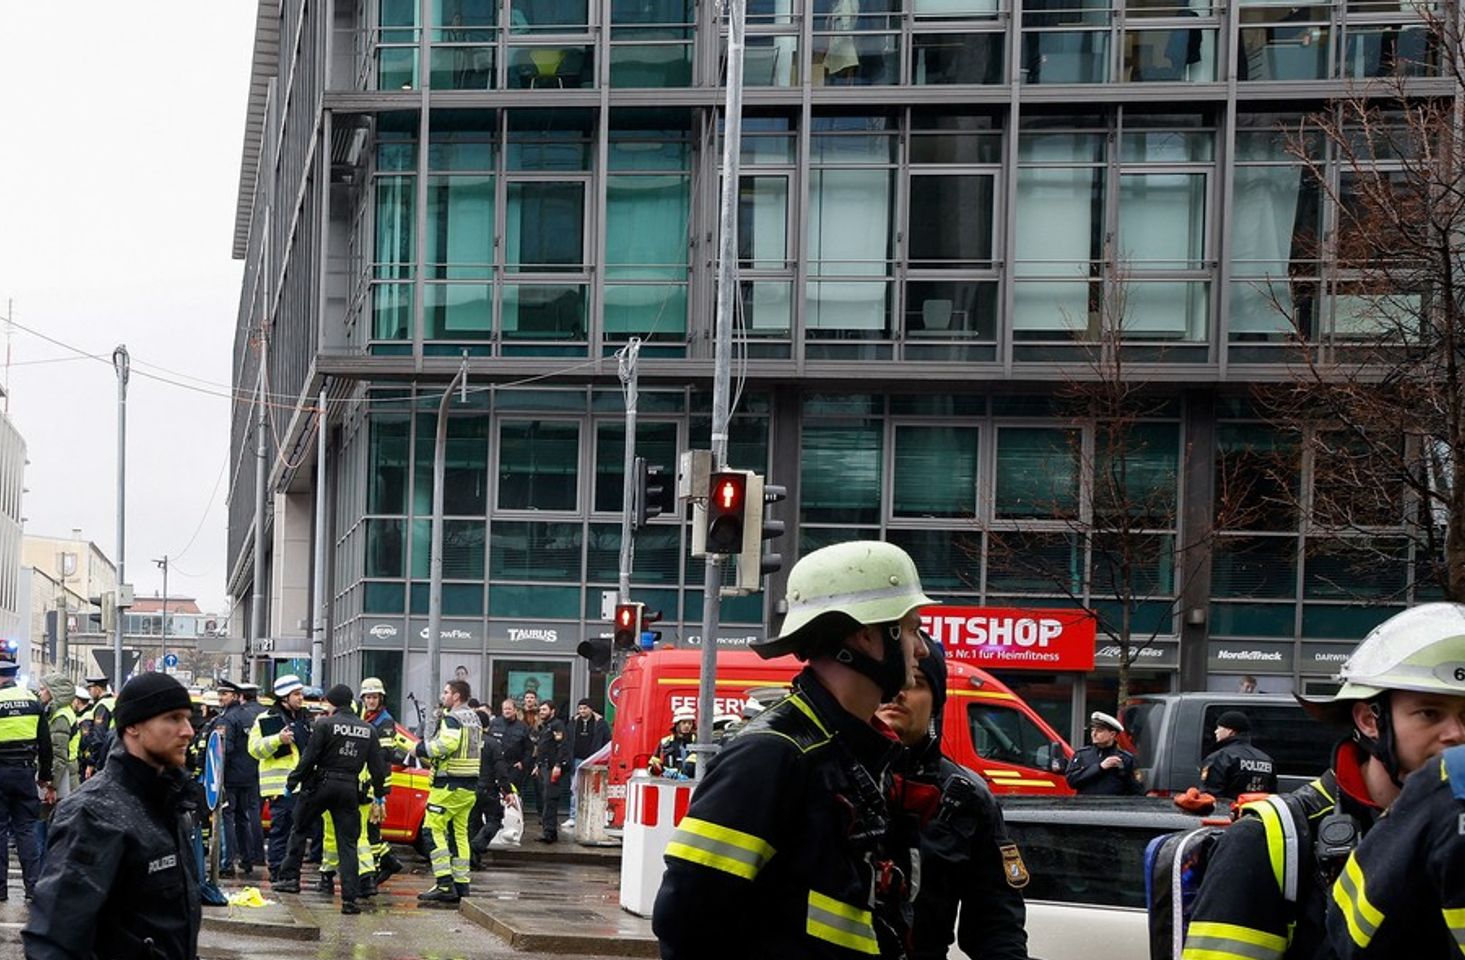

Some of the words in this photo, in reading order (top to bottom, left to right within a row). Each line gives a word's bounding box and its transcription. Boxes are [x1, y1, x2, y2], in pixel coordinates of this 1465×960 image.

[507, 628, 558, 642] TAURUS
[997, 650, 1059, 661] Heimfitness
[1218, 650, 1283, 661] NordicTrack
[334, 724, 371, 738] POLIZEI
[1240, 760, 1272, 773] POLIZEI
[148, 854, 177, 875] POLIZEI
